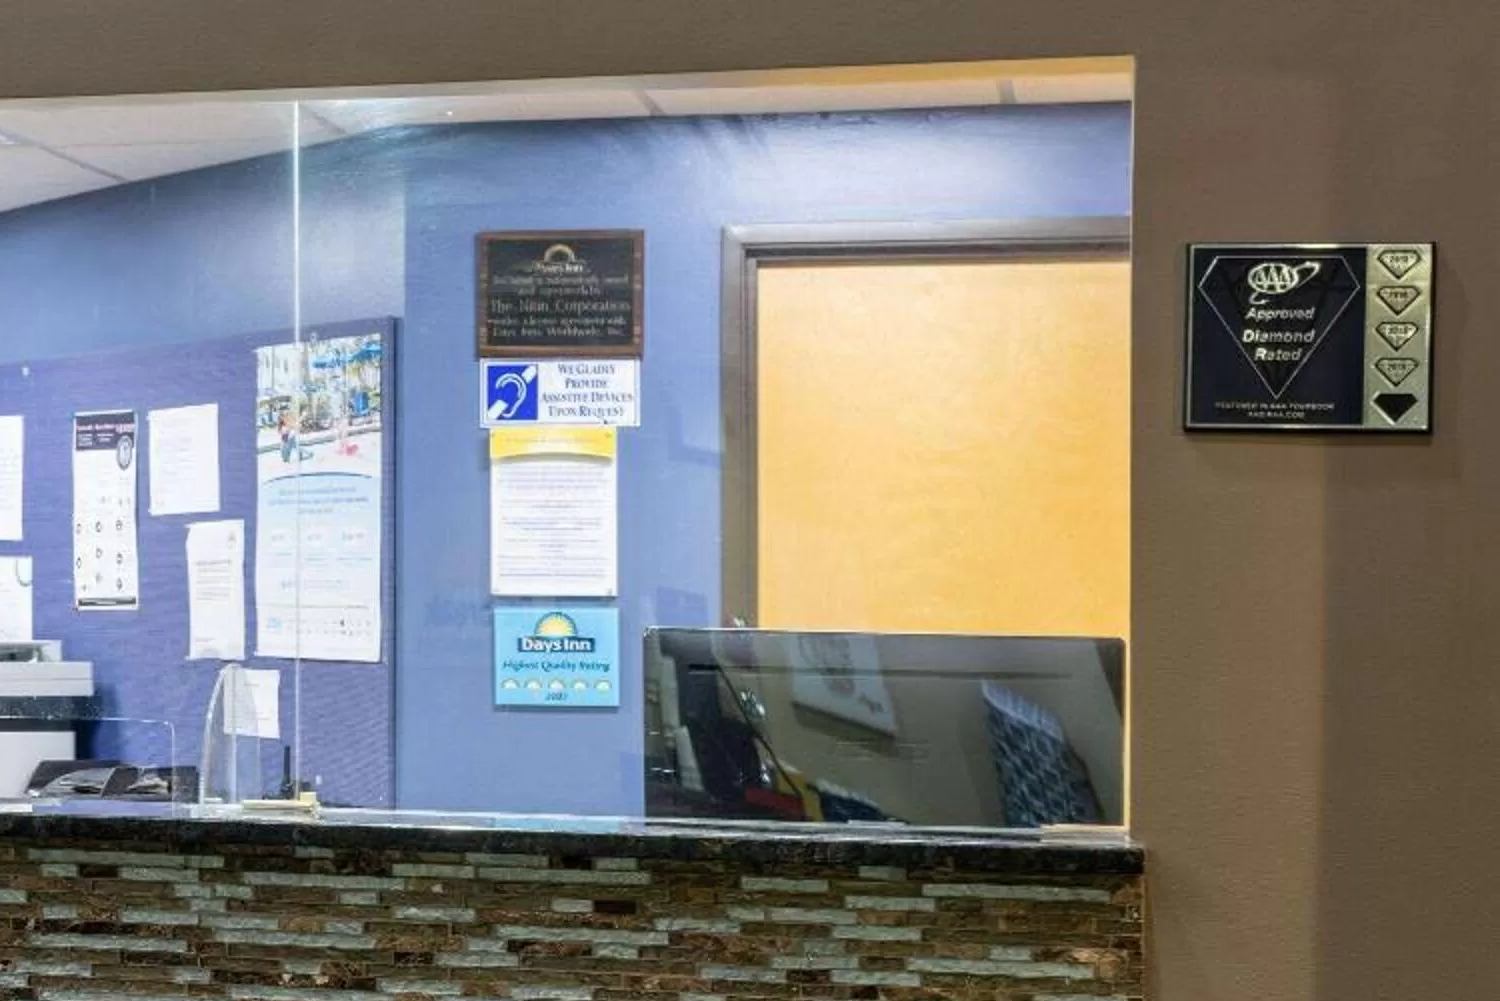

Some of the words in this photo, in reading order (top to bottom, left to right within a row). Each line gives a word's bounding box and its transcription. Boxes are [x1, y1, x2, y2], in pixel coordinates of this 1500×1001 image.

[1253, 264, 1294, 290] AAA
[1244, 306, 1316, 322] Approved
[1243, 328, 1316, 343] Diamond
[1254, 347, 1303, 361] Rated
[521, 637, 562, 653] Days
[563, 637, 592, 651] Inn
[503, 659, 539, 672] Highest
[541, 659, 576, 673] Quality
